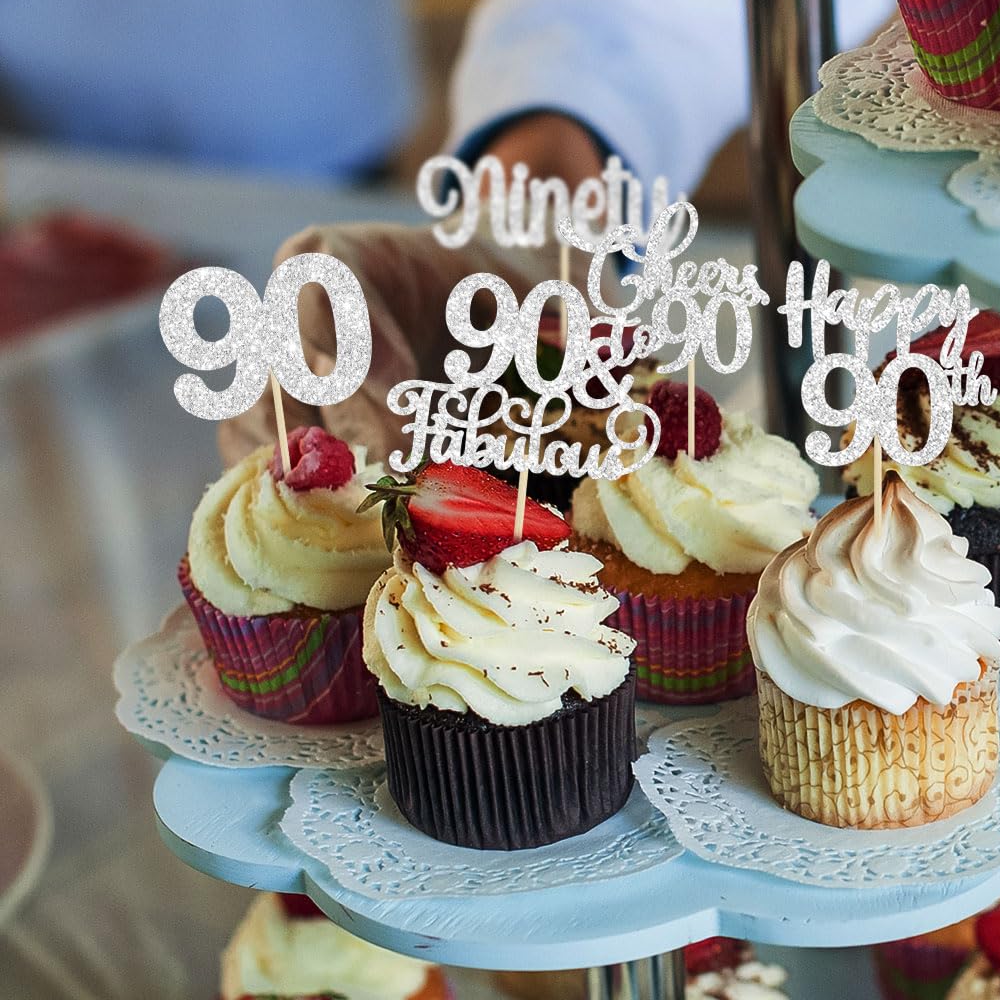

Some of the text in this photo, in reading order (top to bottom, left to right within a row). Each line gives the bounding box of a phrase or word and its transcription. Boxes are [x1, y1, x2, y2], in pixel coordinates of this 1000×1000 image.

[416, 154, 688, 254] Ninety
[557, 201, 770, 316] Cheers
[159, 252, 372, 420] 90
[652, 292, 752, 375] 90
[777, 259, 979, 369] Happy
[387, 379, 661, 480] Fabulous
